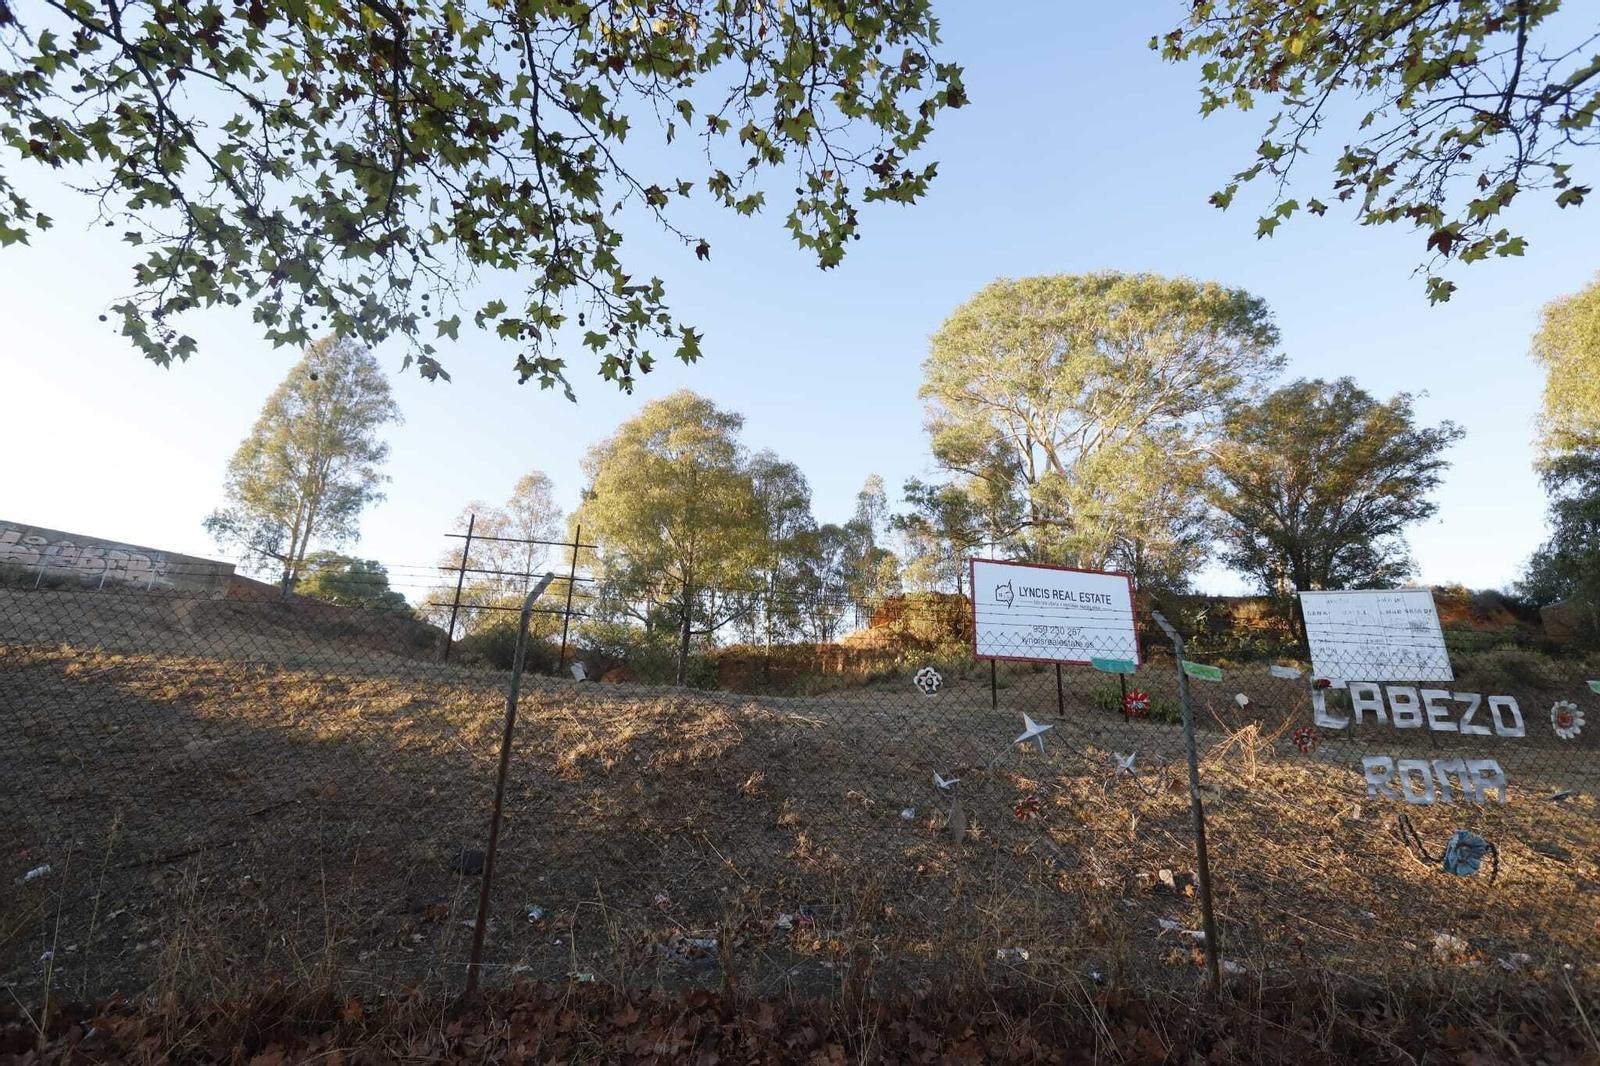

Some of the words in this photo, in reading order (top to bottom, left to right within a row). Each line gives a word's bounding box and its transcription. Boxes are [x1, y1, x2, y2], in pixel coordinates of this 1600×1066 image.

[1018, 586, 1050, 599] LYNCIS
[1052, 589, 1077, 602] REAL
[1079, 592, 1112, 605] ESTATE
[1032, 625, 1048, 634] 959
[1311, 676, 1525, 738] CABEZO
[1361, 755, 1506, 805] ROMA
